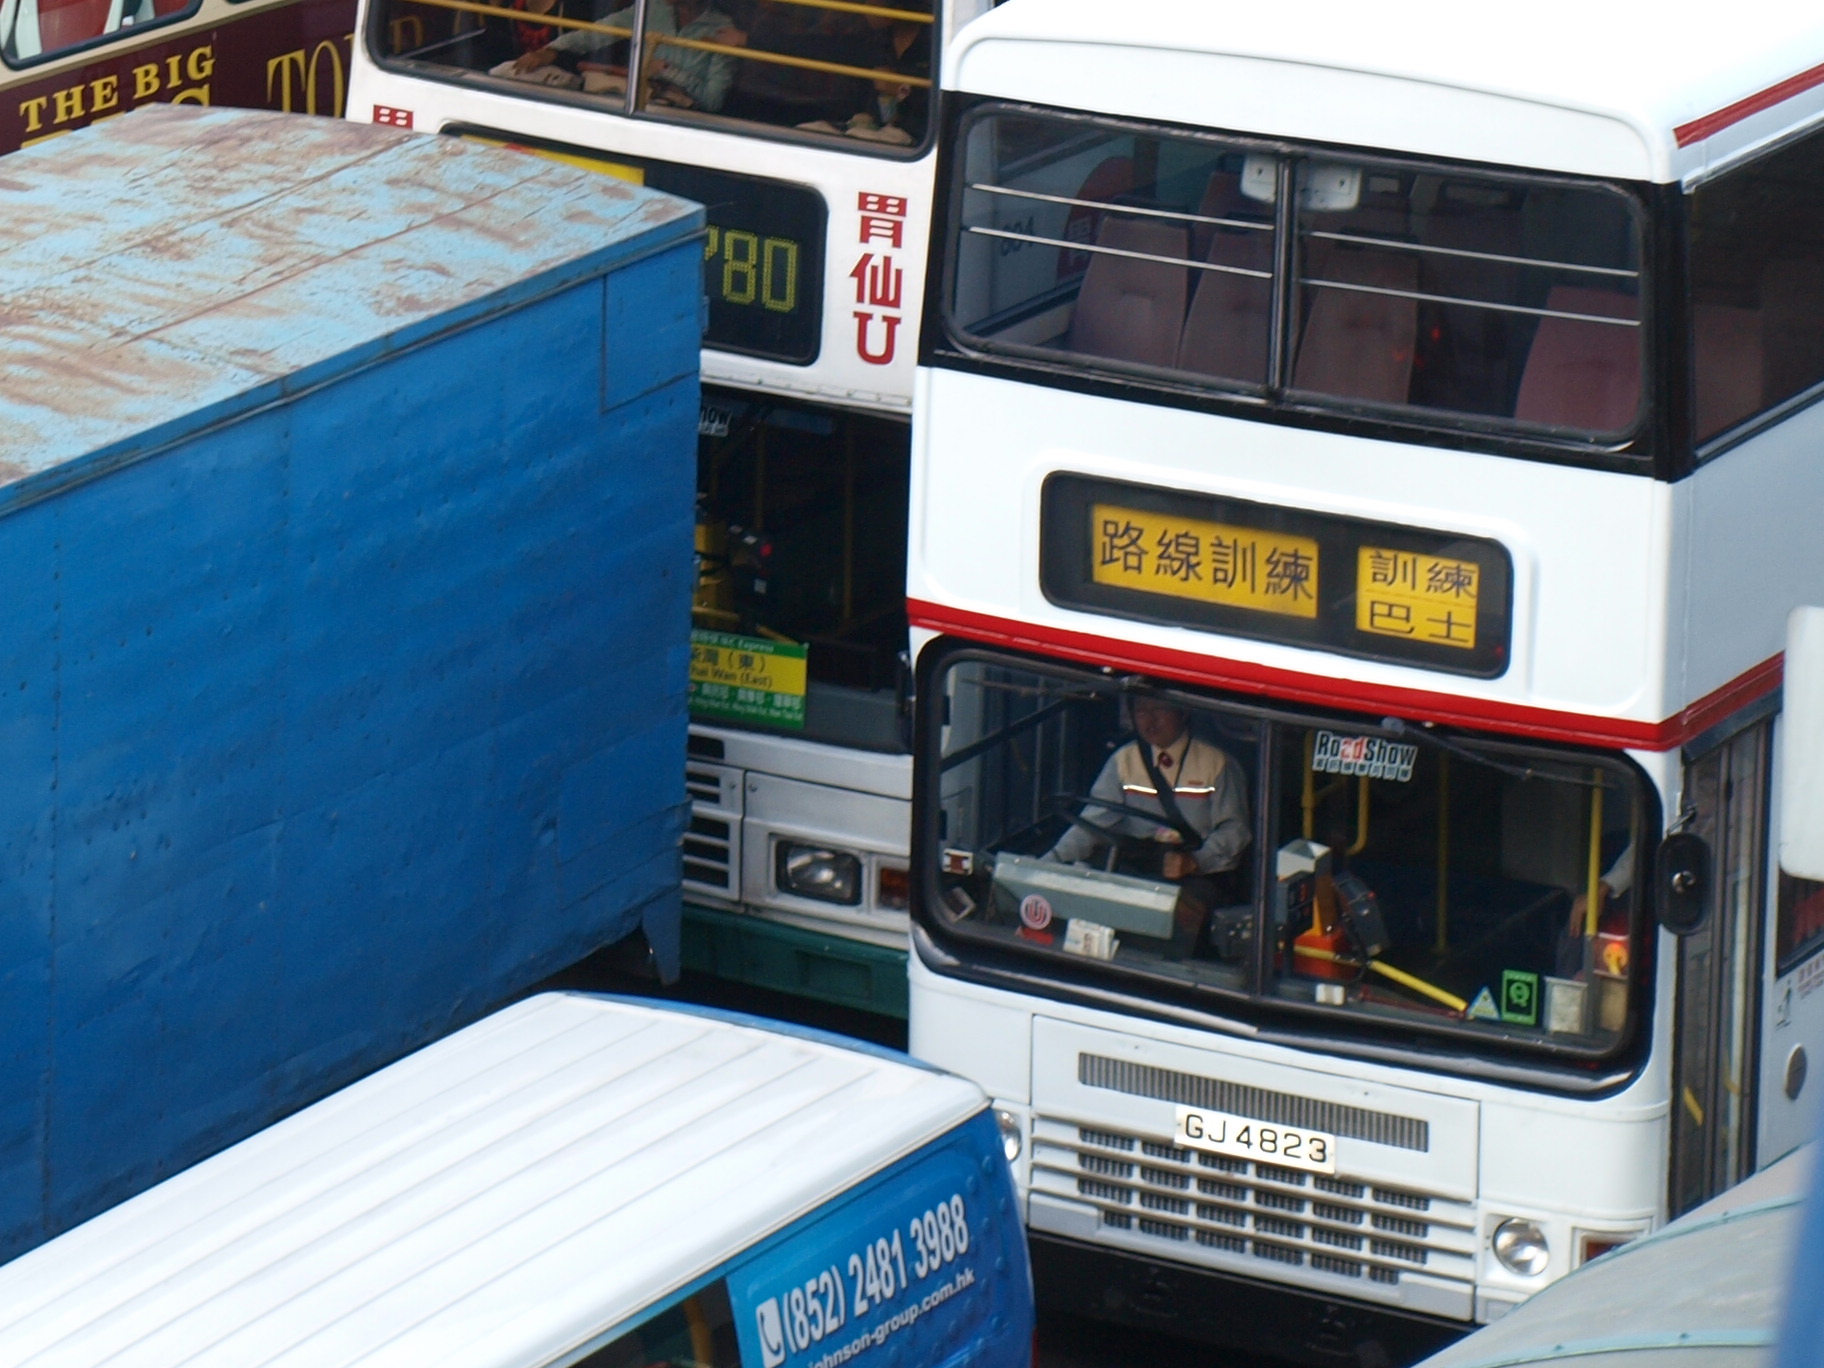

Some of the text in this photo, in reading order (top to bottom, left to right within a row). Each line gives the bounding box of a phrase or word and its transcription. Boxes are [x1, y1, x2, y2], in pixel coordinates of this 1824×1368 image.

[20, 75, 119, 133] THE
[133, 45, 215, 100] BIG
[266, 33, 355, 119] TO
[849, 191, 908, 366] 胃仙U
[1100, 518, 1315, 602] 路線訓練
[1369, 552, 1477, 600] 訓練
[1369, 600, 1474, 645] 巴士
[1185, 1113, 1327, 1163] GJ 4823
[782, 1193, 969, 1355] (852) 2481 3988
